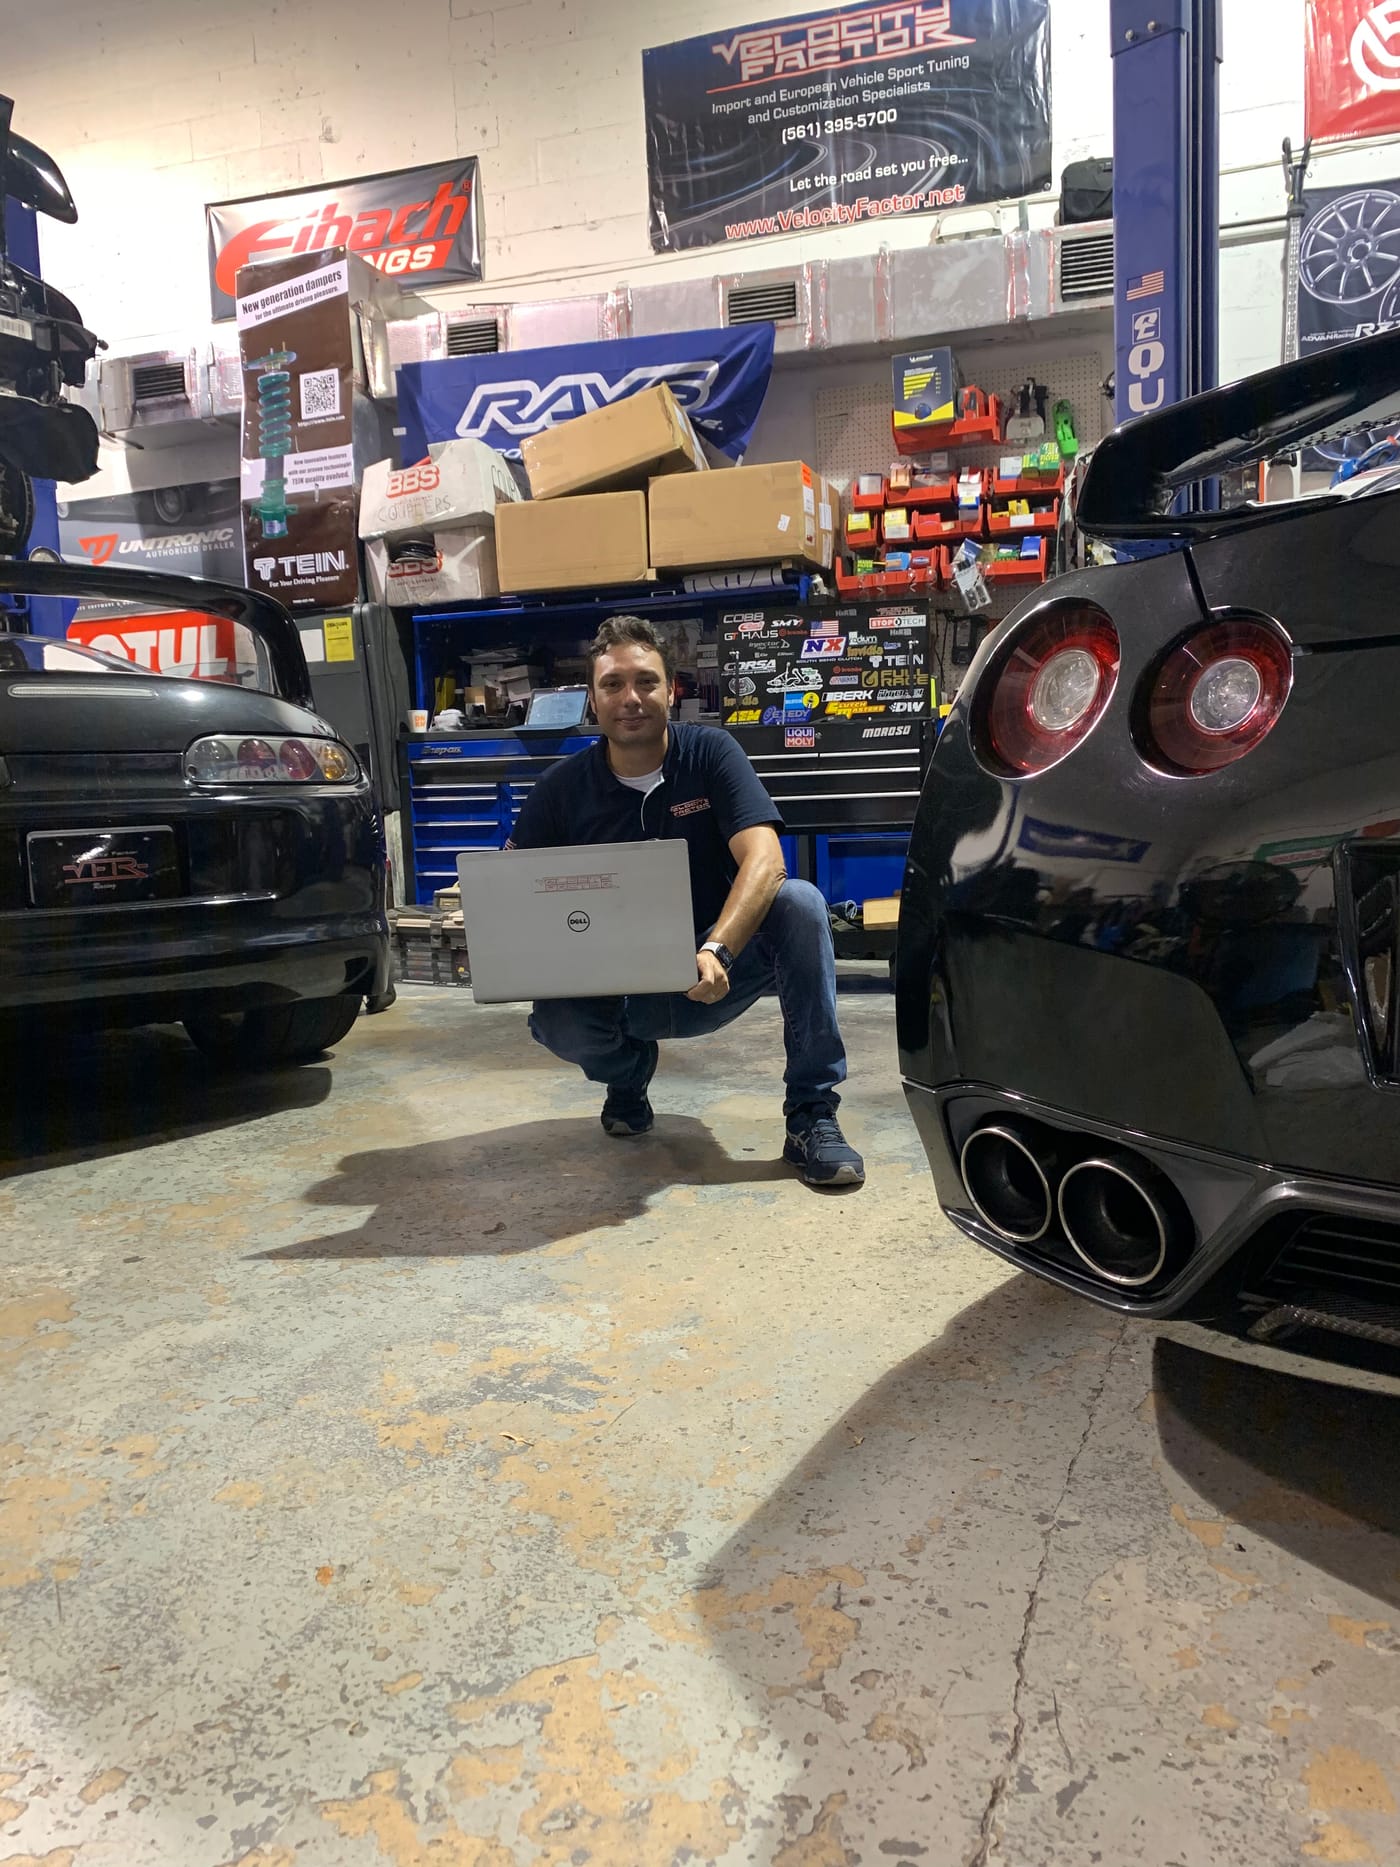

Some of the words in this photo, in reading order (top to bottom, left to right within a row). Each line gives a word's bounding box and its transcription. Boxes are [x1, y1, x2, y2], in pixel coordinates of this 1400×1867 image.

[712, 0, 950, 64] VELOCITY
[741, 21, 976, 82] FACTOR
[712, 95, 752, 114] Import
[755, 91, 777, 106] and
[780, 81, 836, 102] European
[840, 70, 885, 90] Vehicle
[888, 64, 924, 82] Sport
[928, 55, 969, 75] Tuning
[748, 108, 770, 124] and
[773, 95, 858, 120] Customization
[862, 80, 931, 104] Specialists
[782, 120, 821, 144] (561)
[824, 109, 897, 135] 395-5700
[790, 176, 811, 193] Let
[814, 172, 837, 188] the
[840, 166, 872, 184] road
[875, 163, 898, 179] set
[900, 160, 926, 178] you
[928, 152, 969, 170] free...
[725, 183, 965, 239] www.VelocityFactor.net
[215, 182, 469, 297] Eibach
[241, 300, 260, 315] New
[260, 283, 305, 310] generation
[305, 270, 342, 292] dampers
[386, 464, 440, 498] BBS
[119, 528, 234, 553] UNITRONIC
[146, 546, 199, 558] AUTHORIZED
[202, 541, 235, 552] DEALER
[277, 550, 347, 575] TEIN
[269, 580, 279, 588] For
[279, 578, 293, 588] Your
[293, 576, 315, 587] Driving
[315, 574, 340, 585] Pleasure
[723, 612, 764, 623] COBB
[724, 632, 738, 640] GT
[741, 629, 779, 640] HAUS
[804, 638, 845, 653] NX
[67, 625, 229, 678] OTUL
[884, 654, 924, 667] TEIN
[881, 668, 929, 678] FULL
[835, 690, 874, 700] BERK
[786, 737, 813, 746] MOLY
[787, 728, 812, 737] LIQUI
[862, 725, 911, 738] MOROSO
